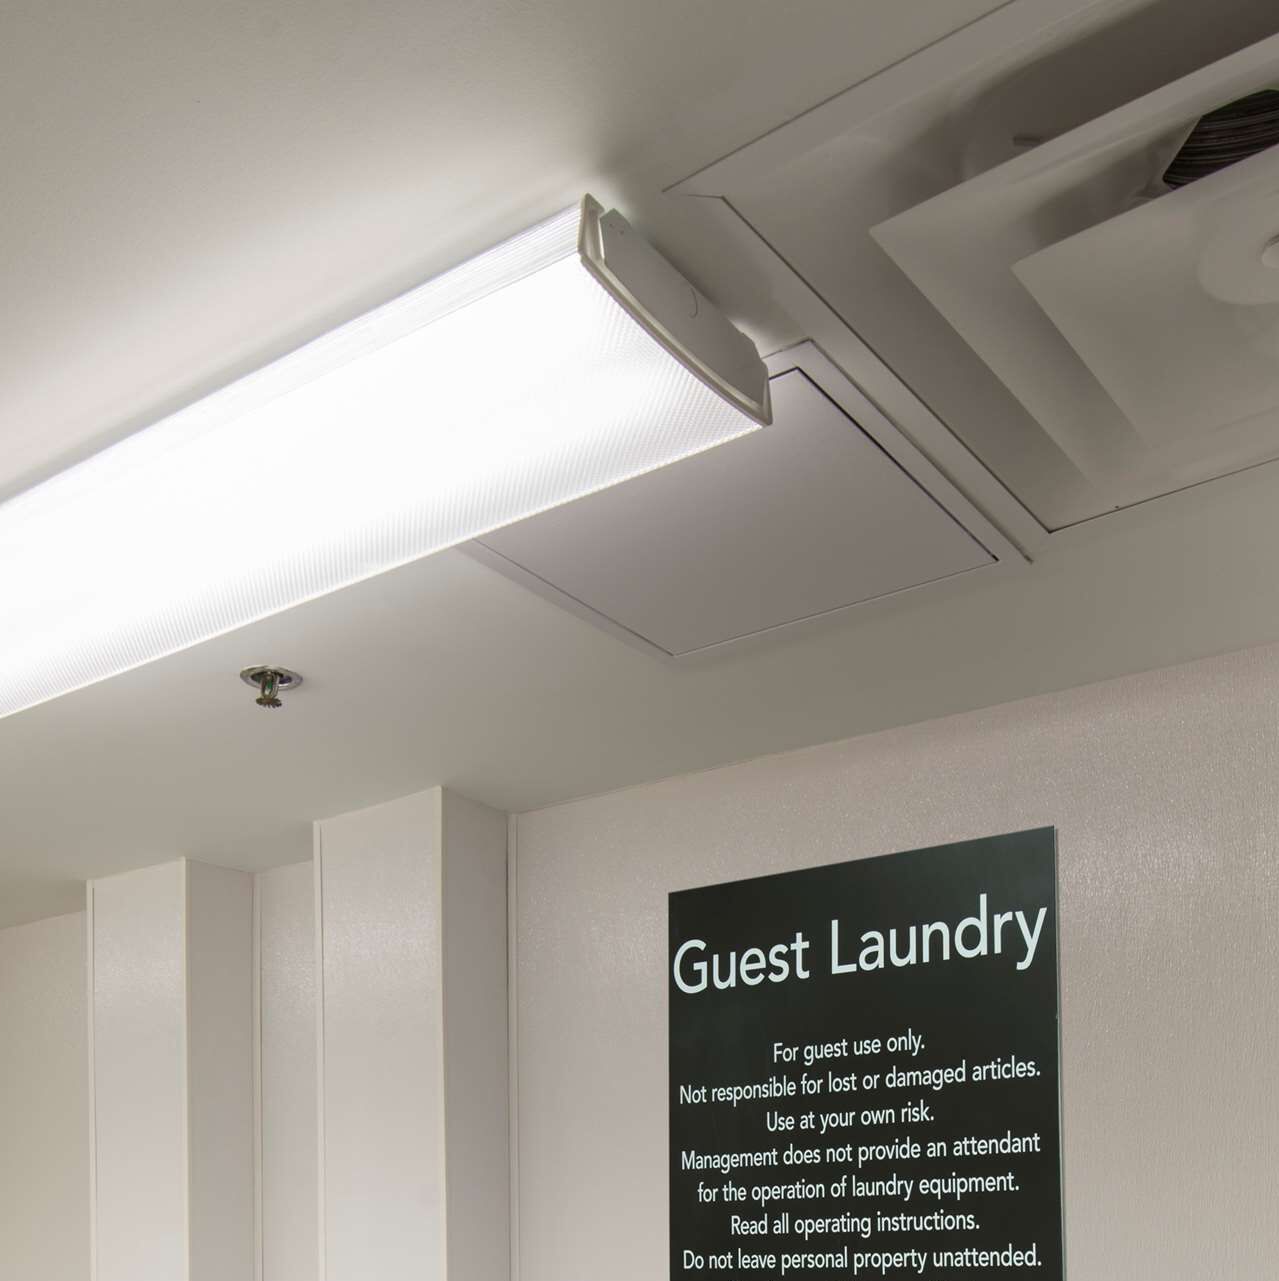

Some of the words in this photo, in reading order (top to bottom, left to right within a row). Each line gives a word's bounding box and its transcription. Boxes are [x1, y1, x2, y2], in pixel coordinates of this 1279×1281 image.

[673, 932, 810, 994] Guest
[831, 893, 1047, 974] Laundry
[774, 1042, 799, 1063] For
[804, 1039, 848, 1066] guest
[854, 1039, 881, 1055] use
[887, 1028, 925, 1056] only.
[680, 1085, 707, 1104] Not
[712, 1075, 796, 1107] responsible
[800, 1073, 823, 1095] for
[829, 1071, 857, 1092] lost
[862, 1074, 880, 1090] or
[885, 1059, 966, 1091] damaged
[972, 1055, 1040, 1081] articles.
[767, 1111, 795, 1132] Use
[800, 1111, 815, 1129] at
[820, 1111, 856, 1134] your
[861, 1109, 895, 1125] own
[901, 1099, 934, 1123] risk.
[682, 1148, 778, 1174] Management
[783, 1143, 821, 1165] does
[826, 1144, 853, 1163] not
[858, 1136, 921, 1168] provide
[927, 1142, 947, 1157] an
[953, 1130, 1041, 1156] attendant
[697, 1181, 718, 1202] for
[722, 1180, 747, 1202] the
[751, 1178, 825, 1207] operation
[830, 1175, 847, 1197] of
[852, 1173, 914, 1201] laundry
[919, 1172, 1019, 1200] equipment.
[731, 1213, 768, 1235] Read
[773, 1212, 789, 1234] all
[794, 1212, 871, 1240] operating
[877, 1209, 980, 1231] instructions.
[683, 1250, 704, 1269] Do
[709, 1252, 733, 1269] not
[738, 1248, 776, 1269] leave
[781, 1246, 848, 1276] personal
[854, 1249, 927, 1275] property
[933, 1243, 1042, 1267] unattended.
